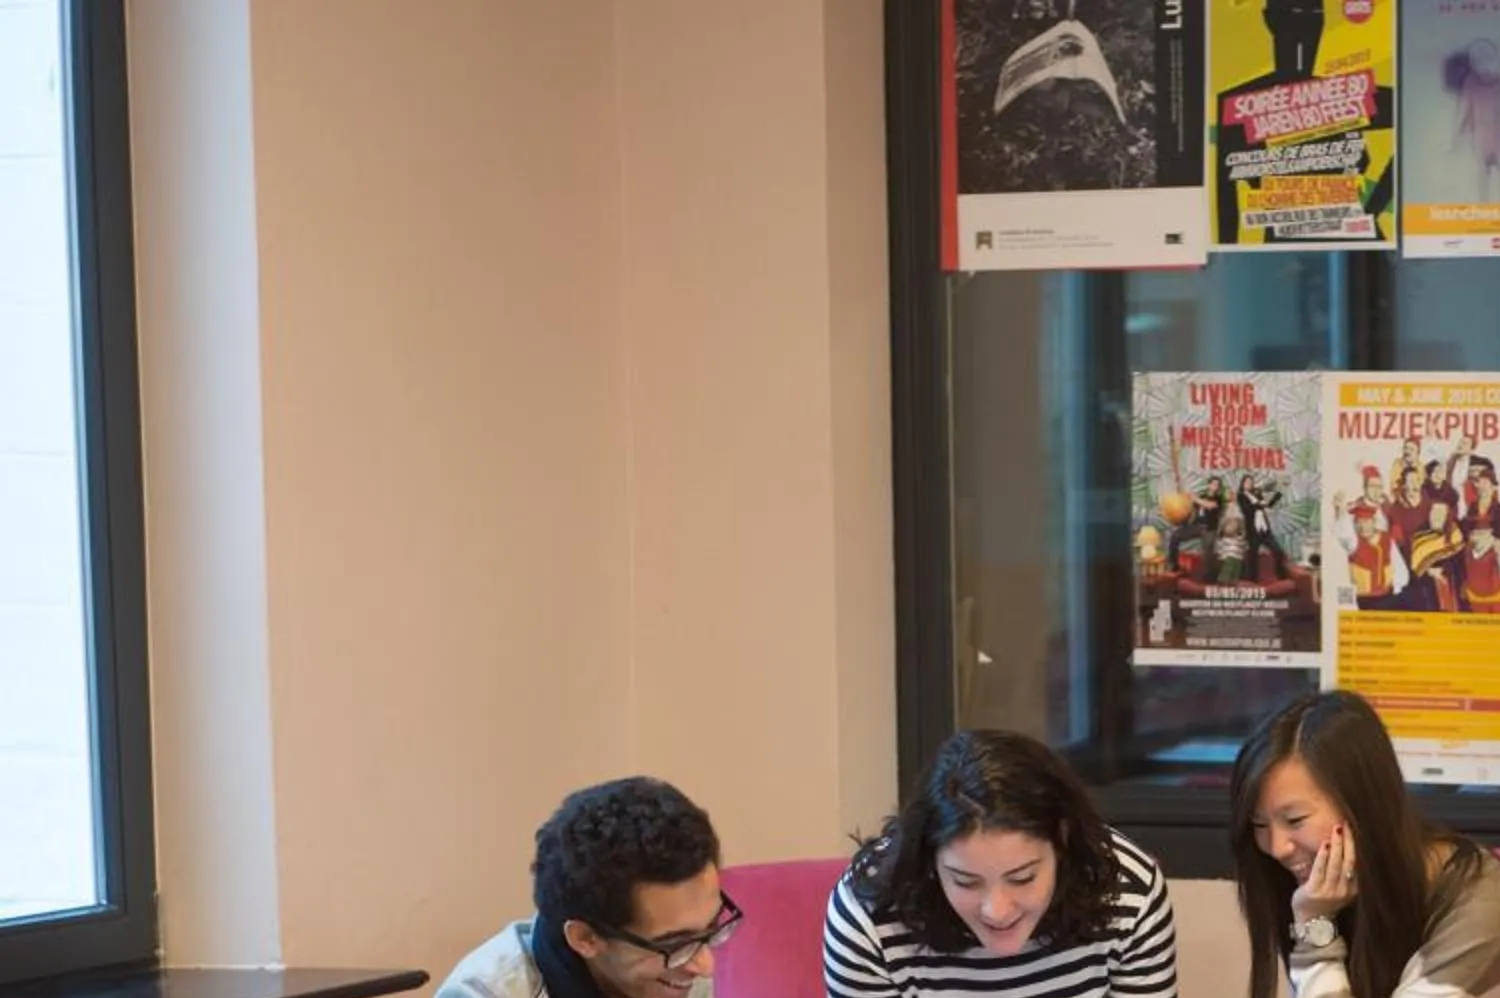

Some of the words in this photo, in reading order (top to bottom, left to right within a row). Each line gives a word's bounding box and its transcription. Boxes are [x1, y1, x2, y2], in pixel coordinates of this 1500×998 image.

[1234, 85, 1290, 118] SOIRÉE
[1290, 77, 1345, 106] ANNÉE
[1347, 74, 1369, 96] 80
[1252, 108, 1300, 138] JAREN
[1302, 106, 1323, 131] 80
[1324, 99, 1367, 124] FEEST
[1190, 383, 1254, 405] LIVING
[1358, 387, 1393, 404] MAY
[1411, 387, 1442, 404] JUNE
[1448, 387, 1483, 405] 2015
[1210, 404, 1267, 426] ROOM
[1181, 426, 1243, 447] MUSIC
[1200, 447, 1286, 470] FESTIVAL
